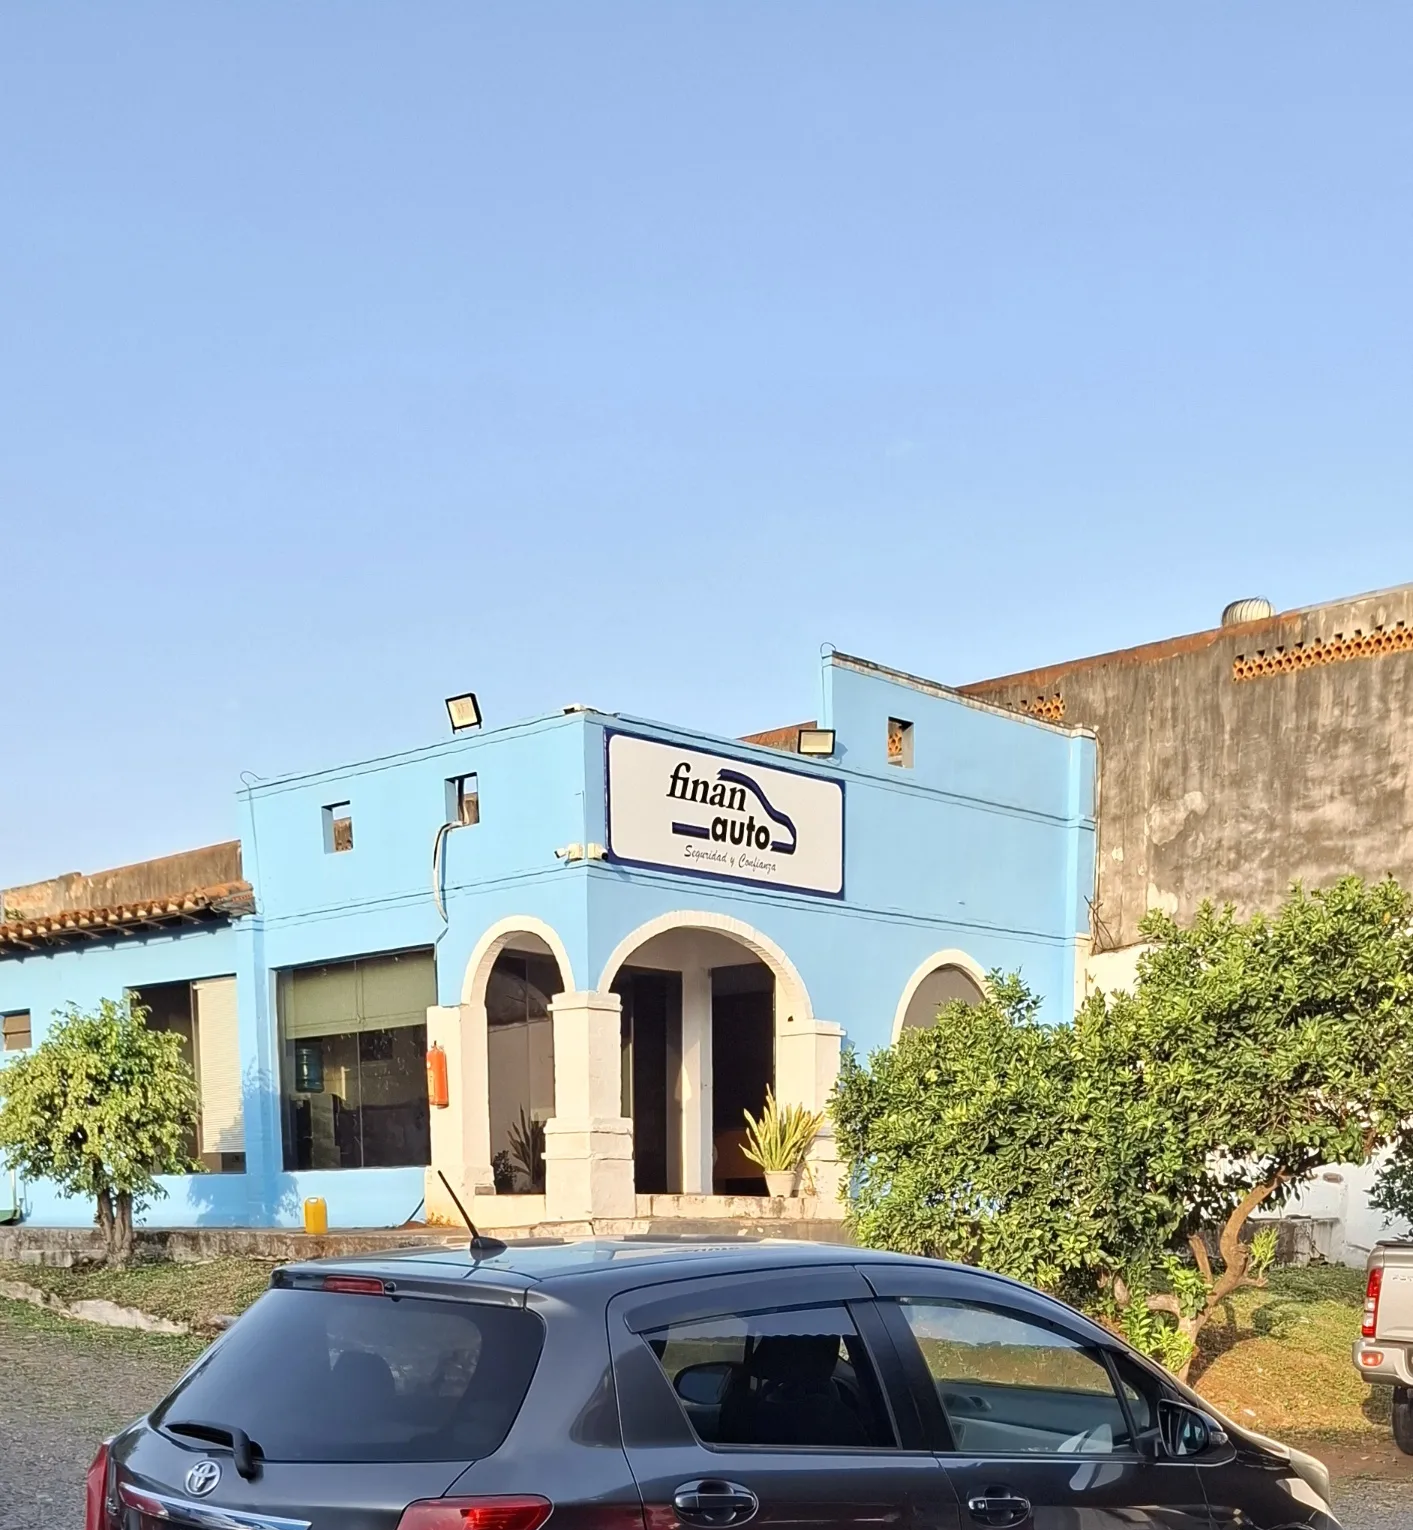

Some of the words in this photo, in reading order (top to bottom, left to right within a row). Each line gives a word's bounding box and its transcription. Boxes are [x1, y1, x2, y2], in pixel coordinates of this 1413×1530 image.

[666, 762, 746, 812] finan
[711, 815, 770, 850] auto
[684, 844, 728, 863] Seguridad
[729, 856, 735, 867] y
[738, 853, 777, 874] Confianza
